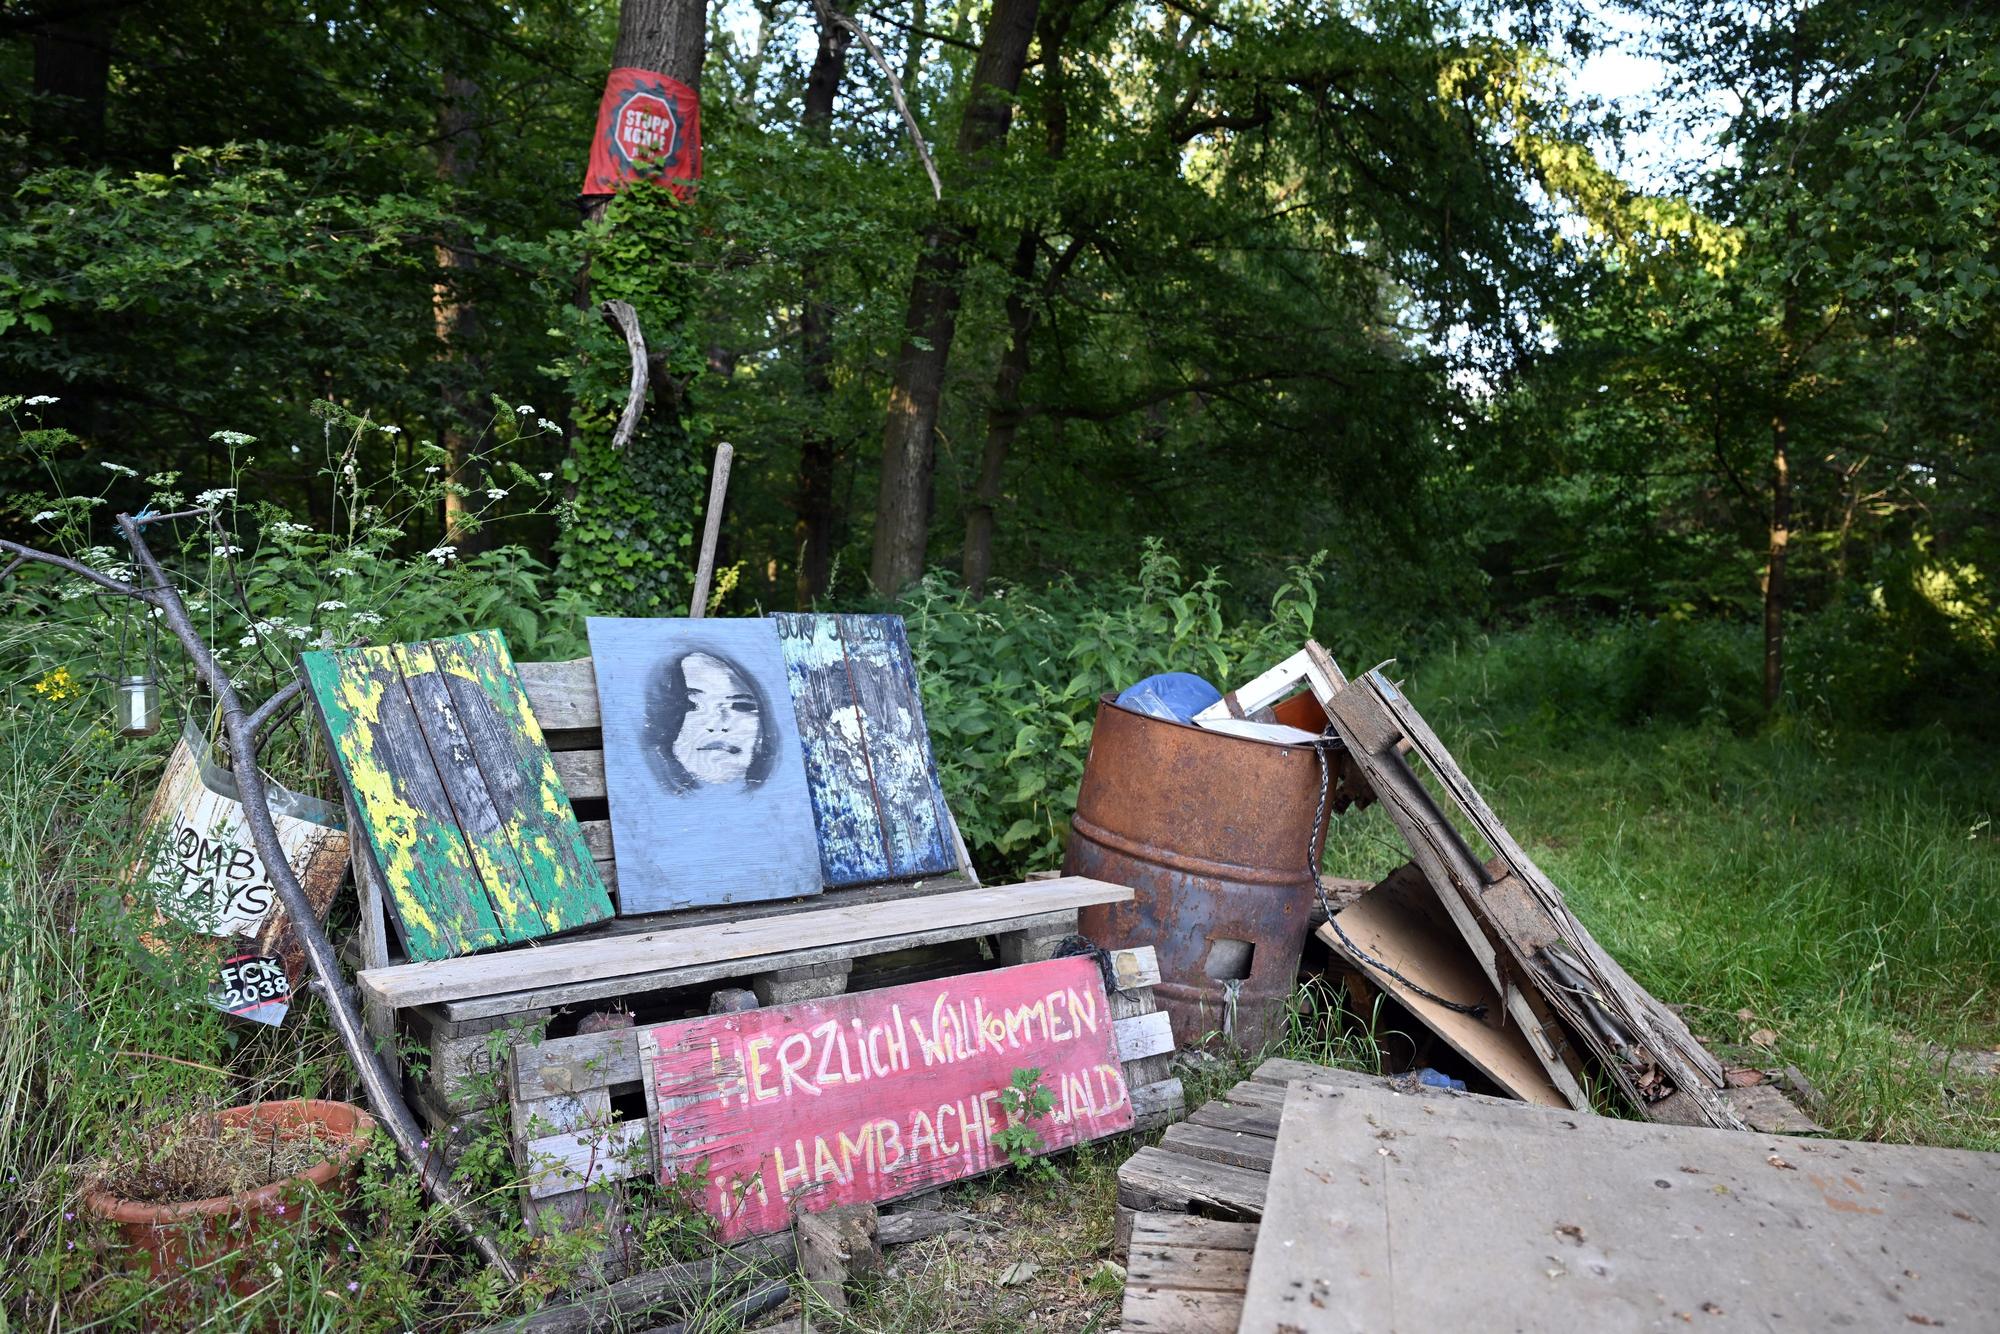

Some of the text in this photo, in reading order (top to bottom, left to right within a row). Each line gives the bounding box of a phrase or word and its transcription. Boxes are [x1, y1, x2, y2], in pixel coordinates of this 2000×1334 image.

[626, 110, 670, 133] STOPP
[171, 810, 270, 883] HAMB
[160, 857, 275, 915] TAYS
[220, 959, 284, 990] FCK
[225, 976, 290, 1008] 2038
